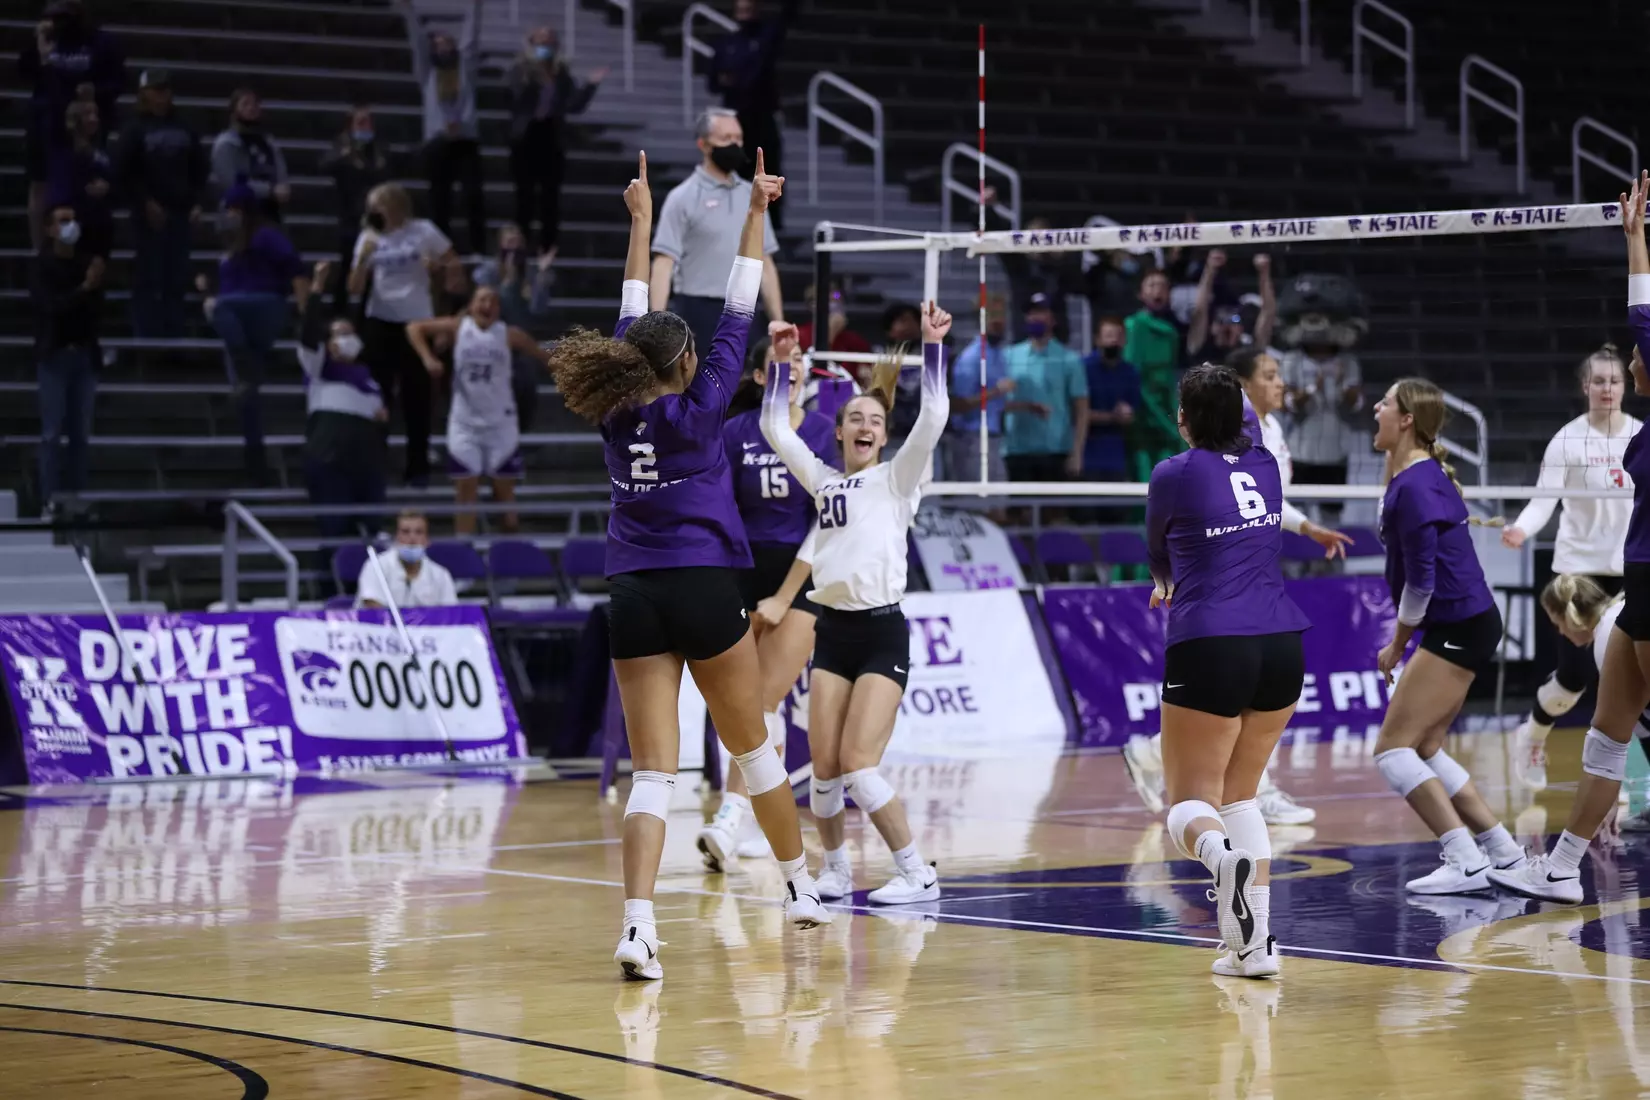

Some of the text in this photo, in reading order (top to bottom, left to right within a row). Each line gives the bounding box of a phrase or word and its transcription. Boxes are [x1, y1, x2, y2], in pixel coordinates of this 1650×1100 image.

[1029, 207, 1568, 247] K-STATE K-STATE K-STATE K-STATE K-STATE
[628, 442, 659, 480] 2
[743, 452, 781, 466] K-ST
[760, 466, 790, 498] 15
[1229, 471, 1267, 519] 6
[819, 493, 848, 530] 20
[79, 624, 256, 683] DRIVE
[20, 680, 78, 701] STATE
[350, 658, 482, 709] 00000
[901, 686, 979, 716] ORE
[90, 678, 250, 735] WITH
[106, 726, 298, 779] PRIDE!
